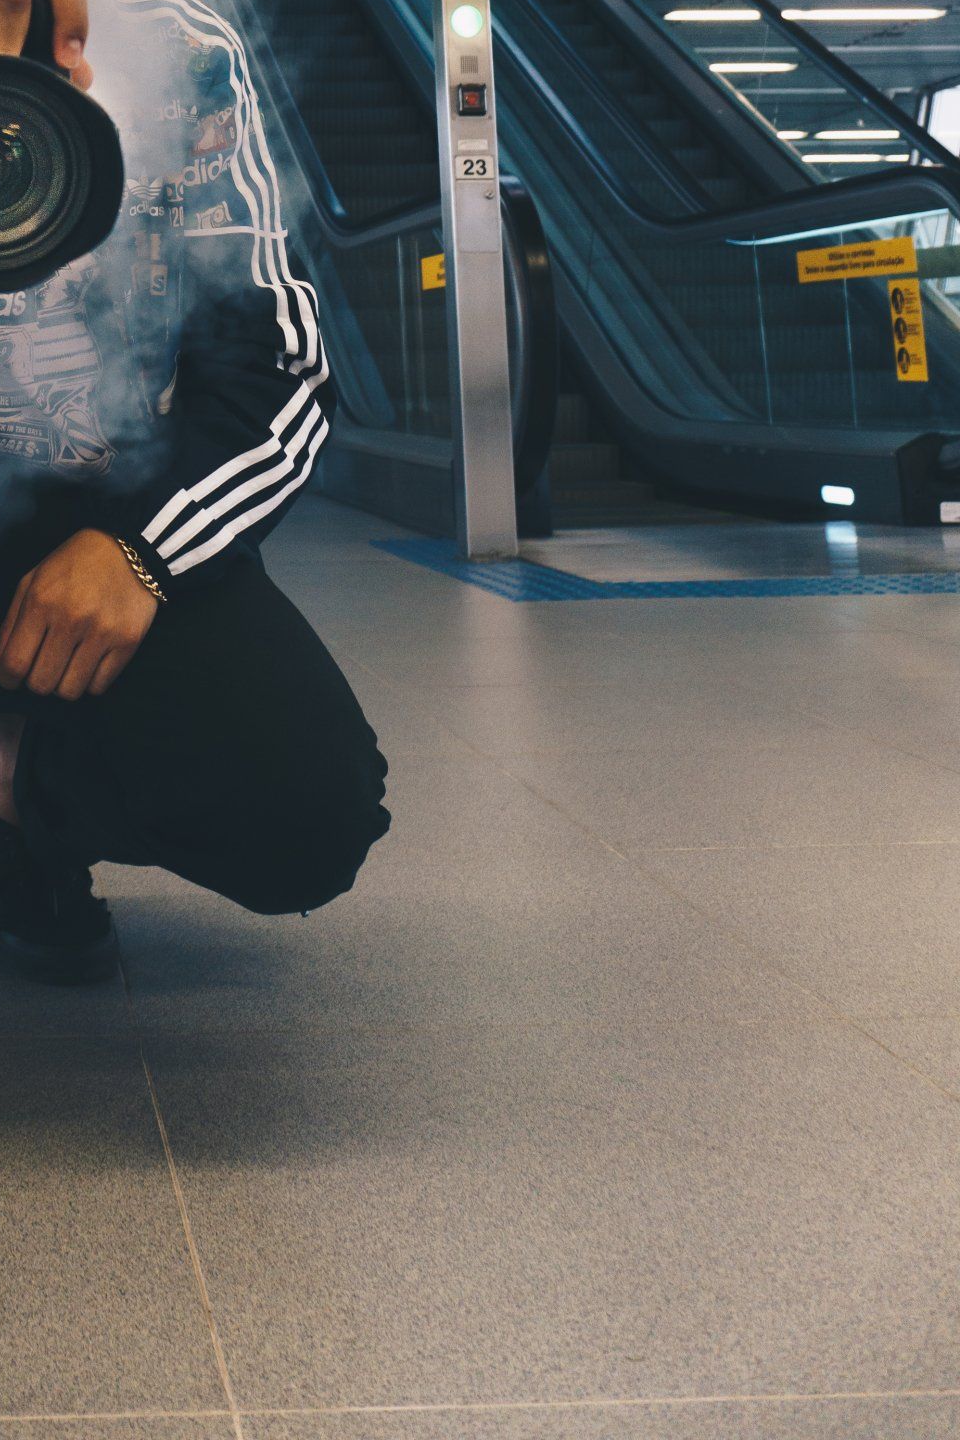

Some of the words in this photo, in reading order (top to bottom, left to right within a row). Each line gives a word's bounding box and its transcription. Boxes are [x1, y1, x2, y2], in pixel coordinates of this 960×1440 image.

[463, 159, 487, 176] 23
[7, 424, 14, 432] IN
[15, 426, 26, 434] THE
